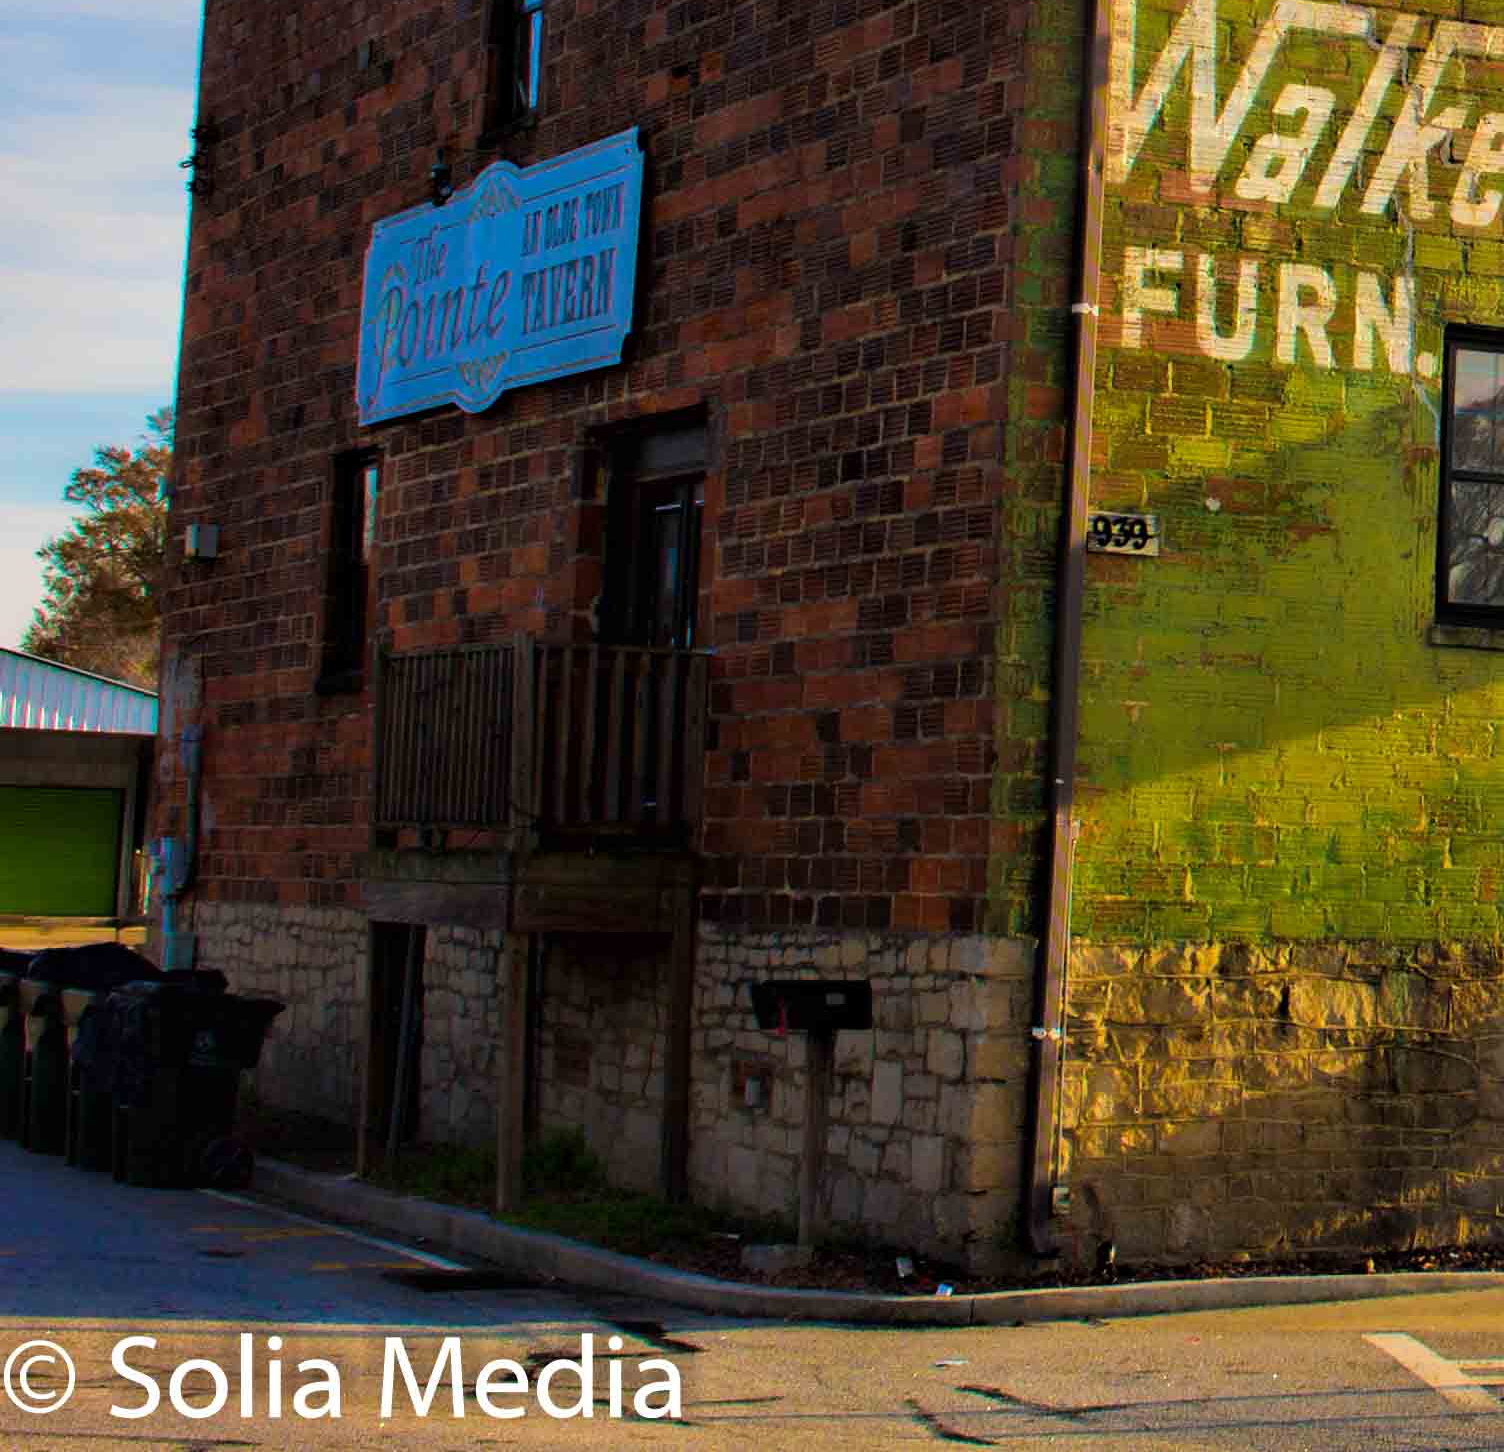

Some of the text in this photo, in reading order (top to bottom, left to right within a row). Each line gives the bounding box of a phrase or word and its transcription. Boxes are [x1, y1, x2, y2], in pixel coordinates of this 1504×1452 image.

[413, 225, 448, 286] The
[522, 181, 625, 255] AN OLDE TOWN
[520, 247, 617, 336] TAVERN
[1120, 244, 1440, 380] FURN.
[366, 259, 512, 410] Pointe
[1093, 514, 1152, 550] 939
